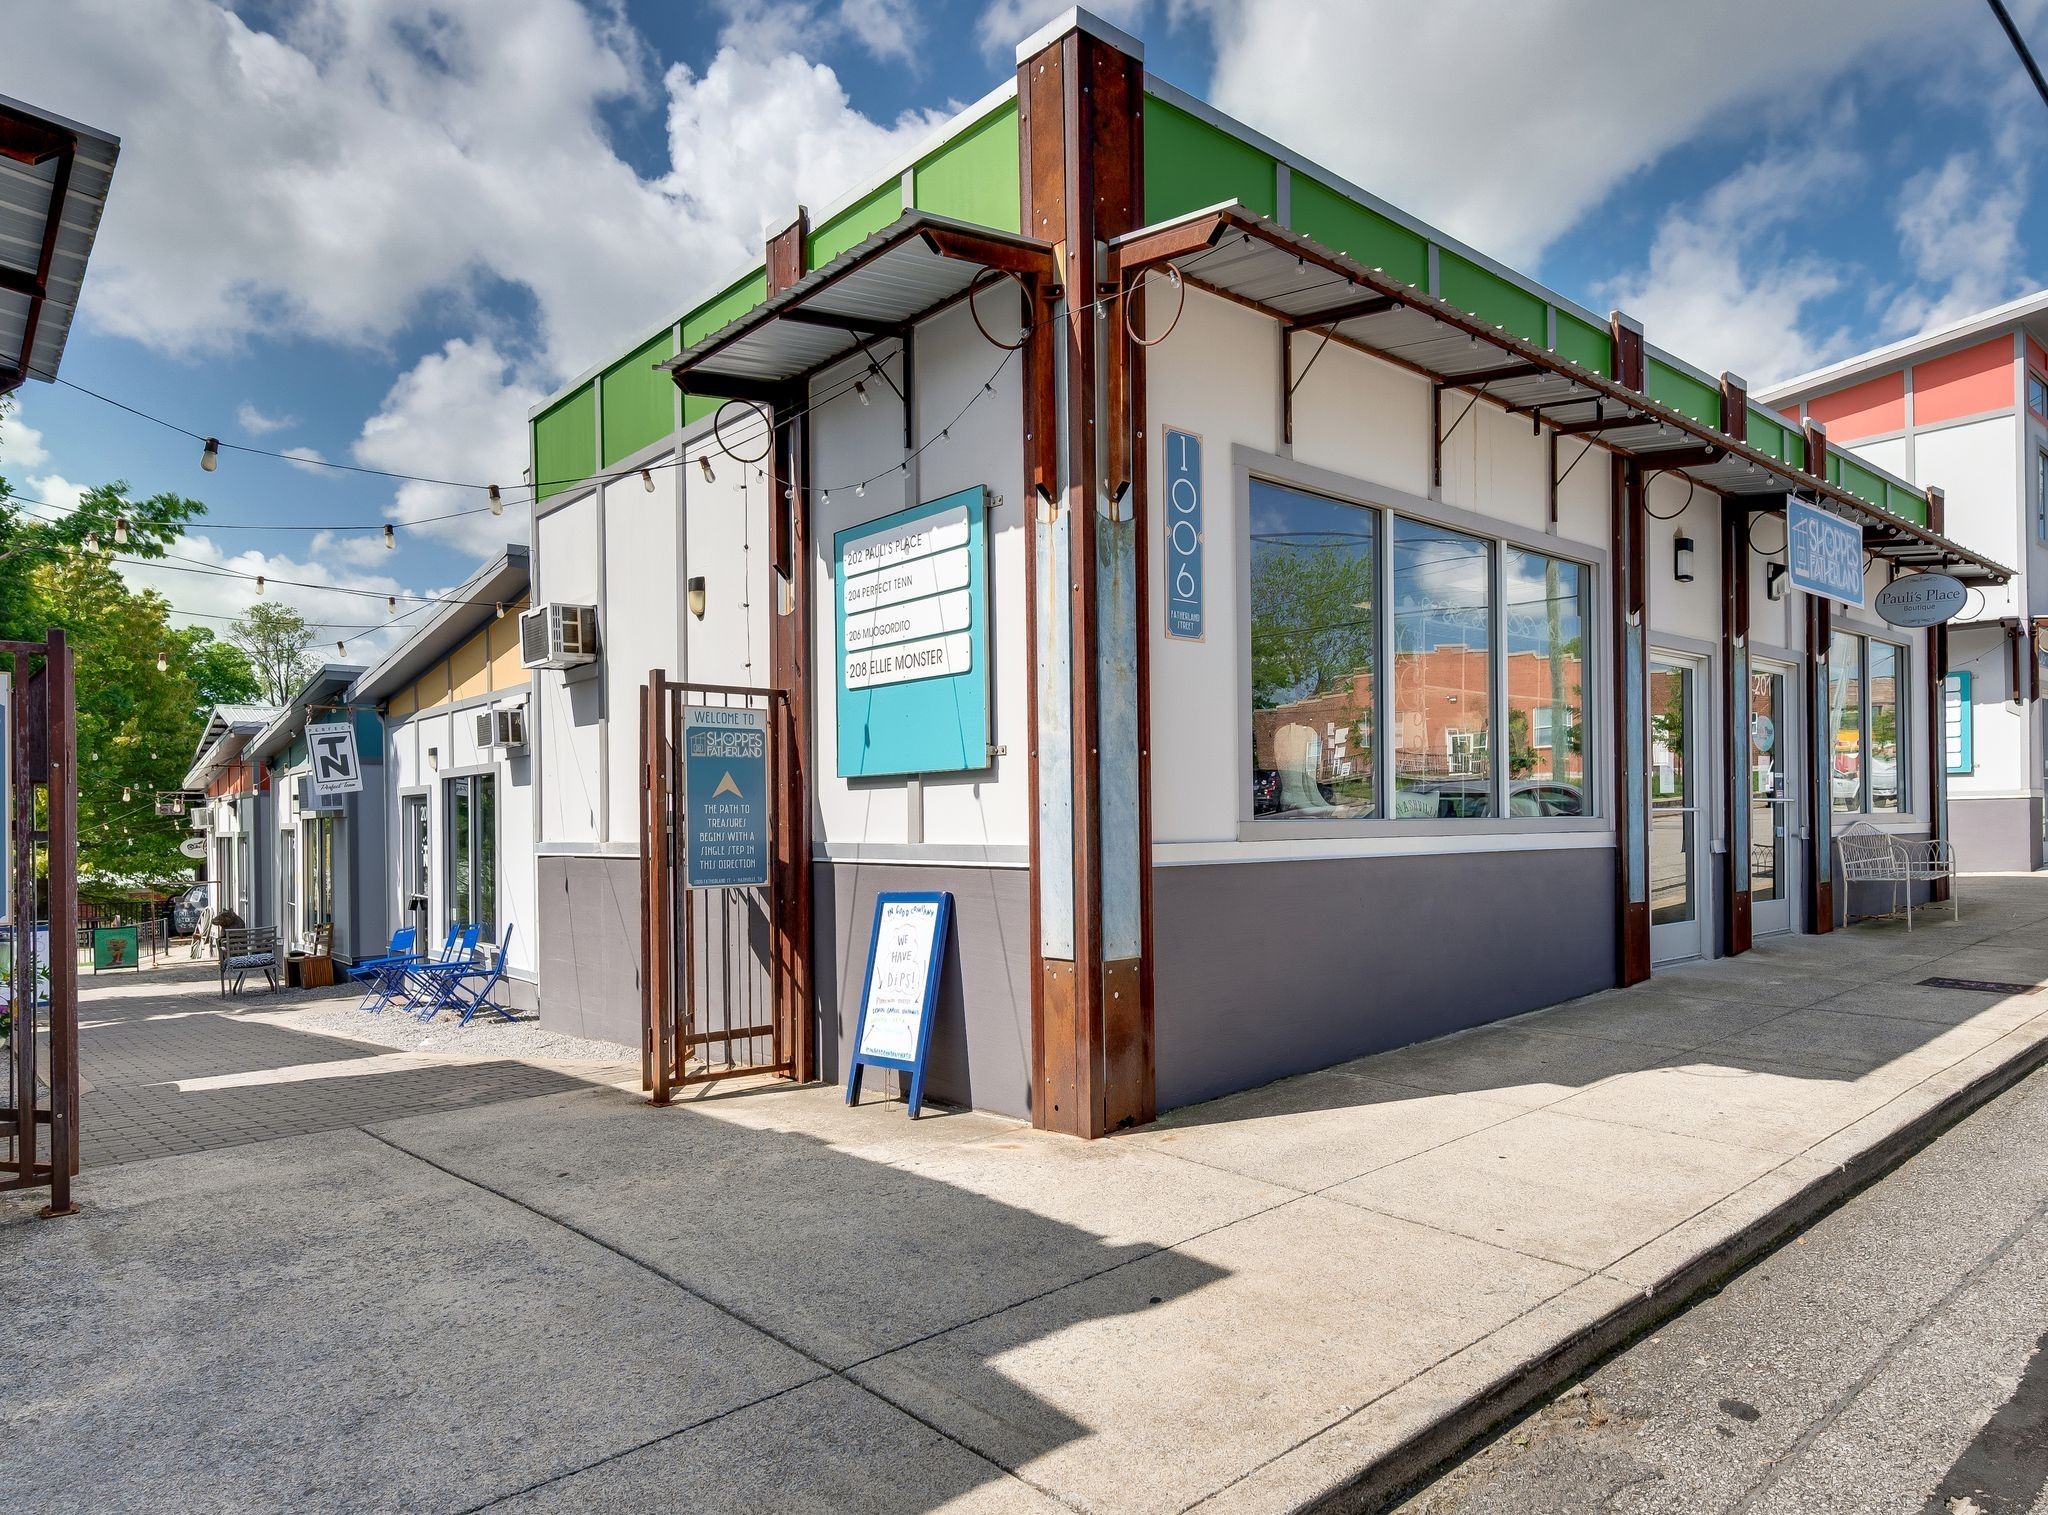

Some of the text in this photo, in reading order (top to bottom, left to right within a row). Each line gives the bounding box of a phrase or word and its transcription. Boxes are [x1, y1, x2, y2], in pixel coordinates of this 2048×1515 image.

[1172, 436, 1197, 598] 1006
[848, 533, 922, 566] 202 PAULI'S PLACE
[1808, 517, 1859, 571] SHOPPES
[1809, 553, 1860, 596] FATHERLAND
[848, 575, 913, 602] 204 PERFECT TENN
[1882, 589, 1961, 605] Pauli's Place
[1903, 602, 1936, 613] Boutique
[1170, 609, 1200, 622] FATHERLAND
[848, 630, 861, 641] 206
[849, 648, 943, 678] 208 ELLIE MONSTER
[1754, 675, 1772, 697] 201
[694, 711, 755, 726] WELCOME TO
[308, 725, 352, 733] PERFECT
[706, 731, 763, 747] SHOPPES
[706, 745, 763, 758] FATHERLAND
[704, 804, 750, 814] THE PATH TO
[707, 818, 747, 828] TREASURES
[699, 831, 755, 842] BEGINS WITH A
[700, 845, 755, 856] SINGLE STEP IN
[700, 858, 756, 870] THIS DIRECTION
[897, 934, 909, 946] WE
[891, 950, 912, 964] HAVE
